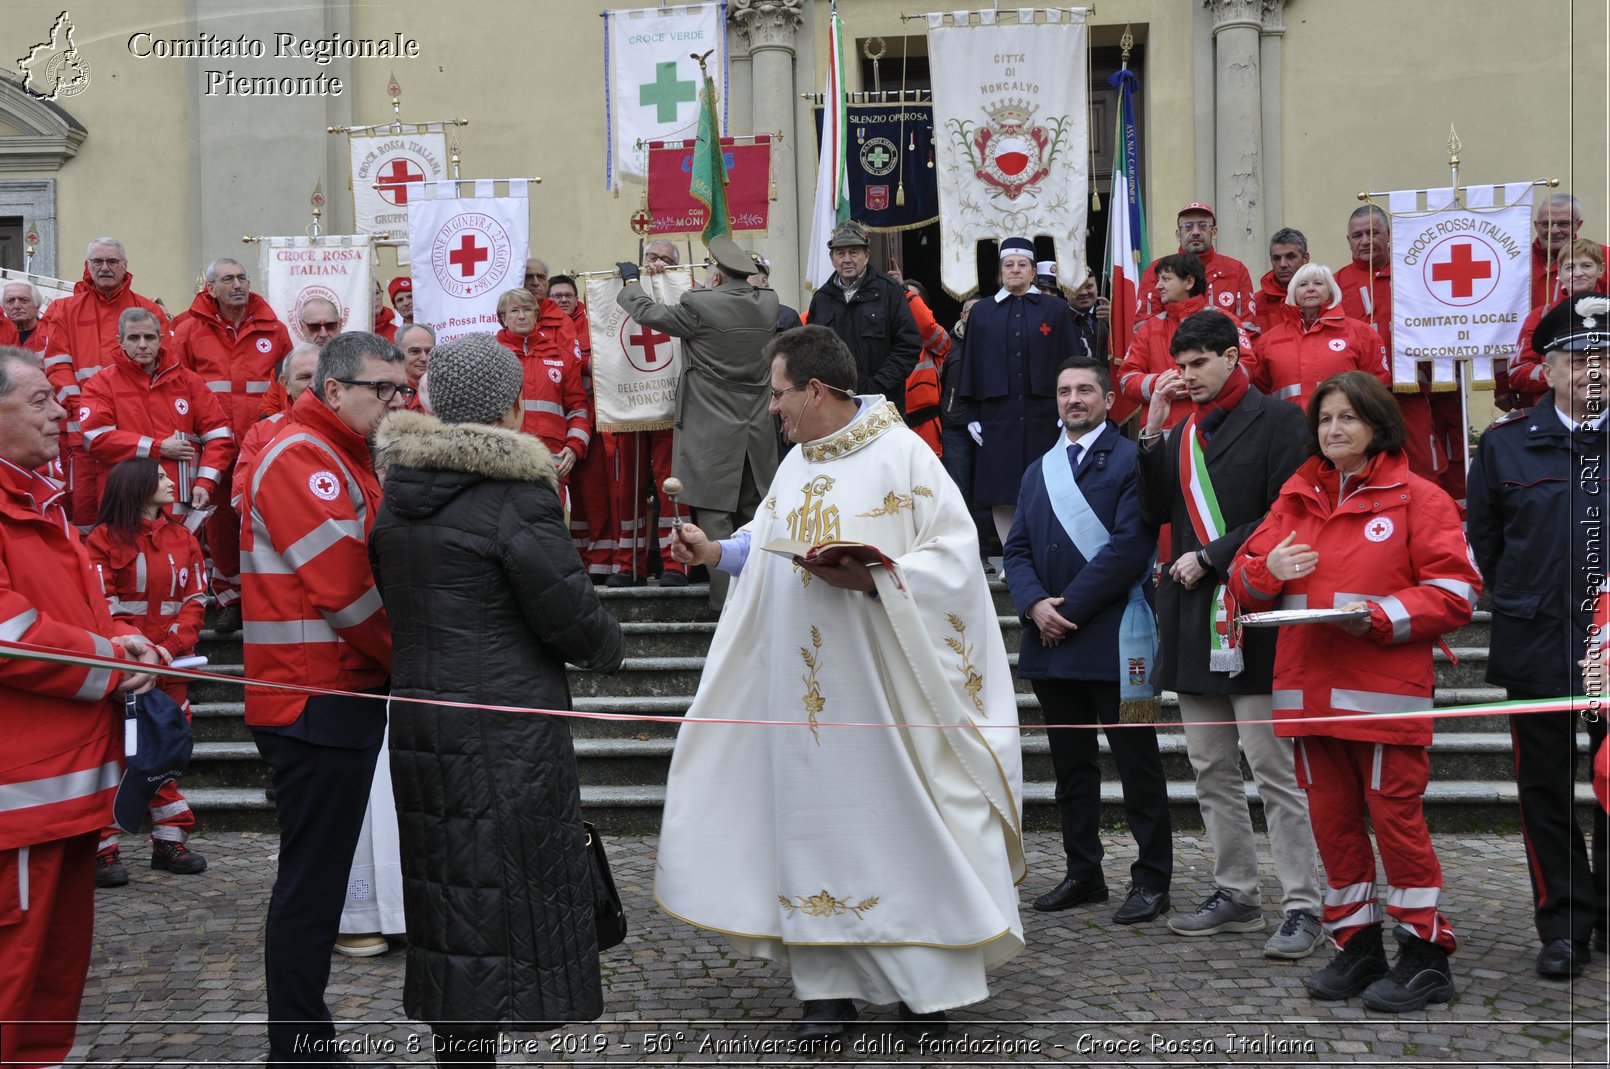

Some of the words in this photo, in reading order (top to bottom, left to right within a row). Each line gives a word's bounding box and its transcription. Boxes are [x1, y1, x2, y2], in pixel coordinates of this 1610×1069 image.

[629, 33, 665, 45] CROCE
[669, 30, 704, 41] VERDE
[1005, 68, 1016, 77] DI
[980, 81, 1040, 95] MONCALVO
[849, 115, 886, 124] SILENZIO
[359, 151, 378, 179] CROCE
[377, 140, 405, 155] ROSSA
[409, 141, 442, 176] ITALIANA
[452, 215, 492, 232] GINEVRA
[442, 225, 452, 237] DI
[492, 231, 504, 243] 22
[1404, 227, 1438, 266] CROCE
[1436, 218, 1476, 236] ROSSA
[1478, 220, 1521, 261] ITALIANA
[276, 251, 316, 262] CROCE
[322, 250, 362, 261] ROSSA
[489, 244, 508, 281] AGOSTO
[289, 265, 348, 276] ITALIANA
[434, 239, 464, 295] CONVENZIONE
[474, 279, 492, 293] 1864
[449, 316, 477, 327] Rossa
[606, 308, 624, 338] CROCE
[1405, 315, 1468, 327] COMITATO
[1472, 313, 1518, 324] LOCALE
[1458, 331, 1470, 340] DI
[1405, 345, 1480, 357] COCCONATO
[618, 378, 677, 394] DELEGAZIONE
